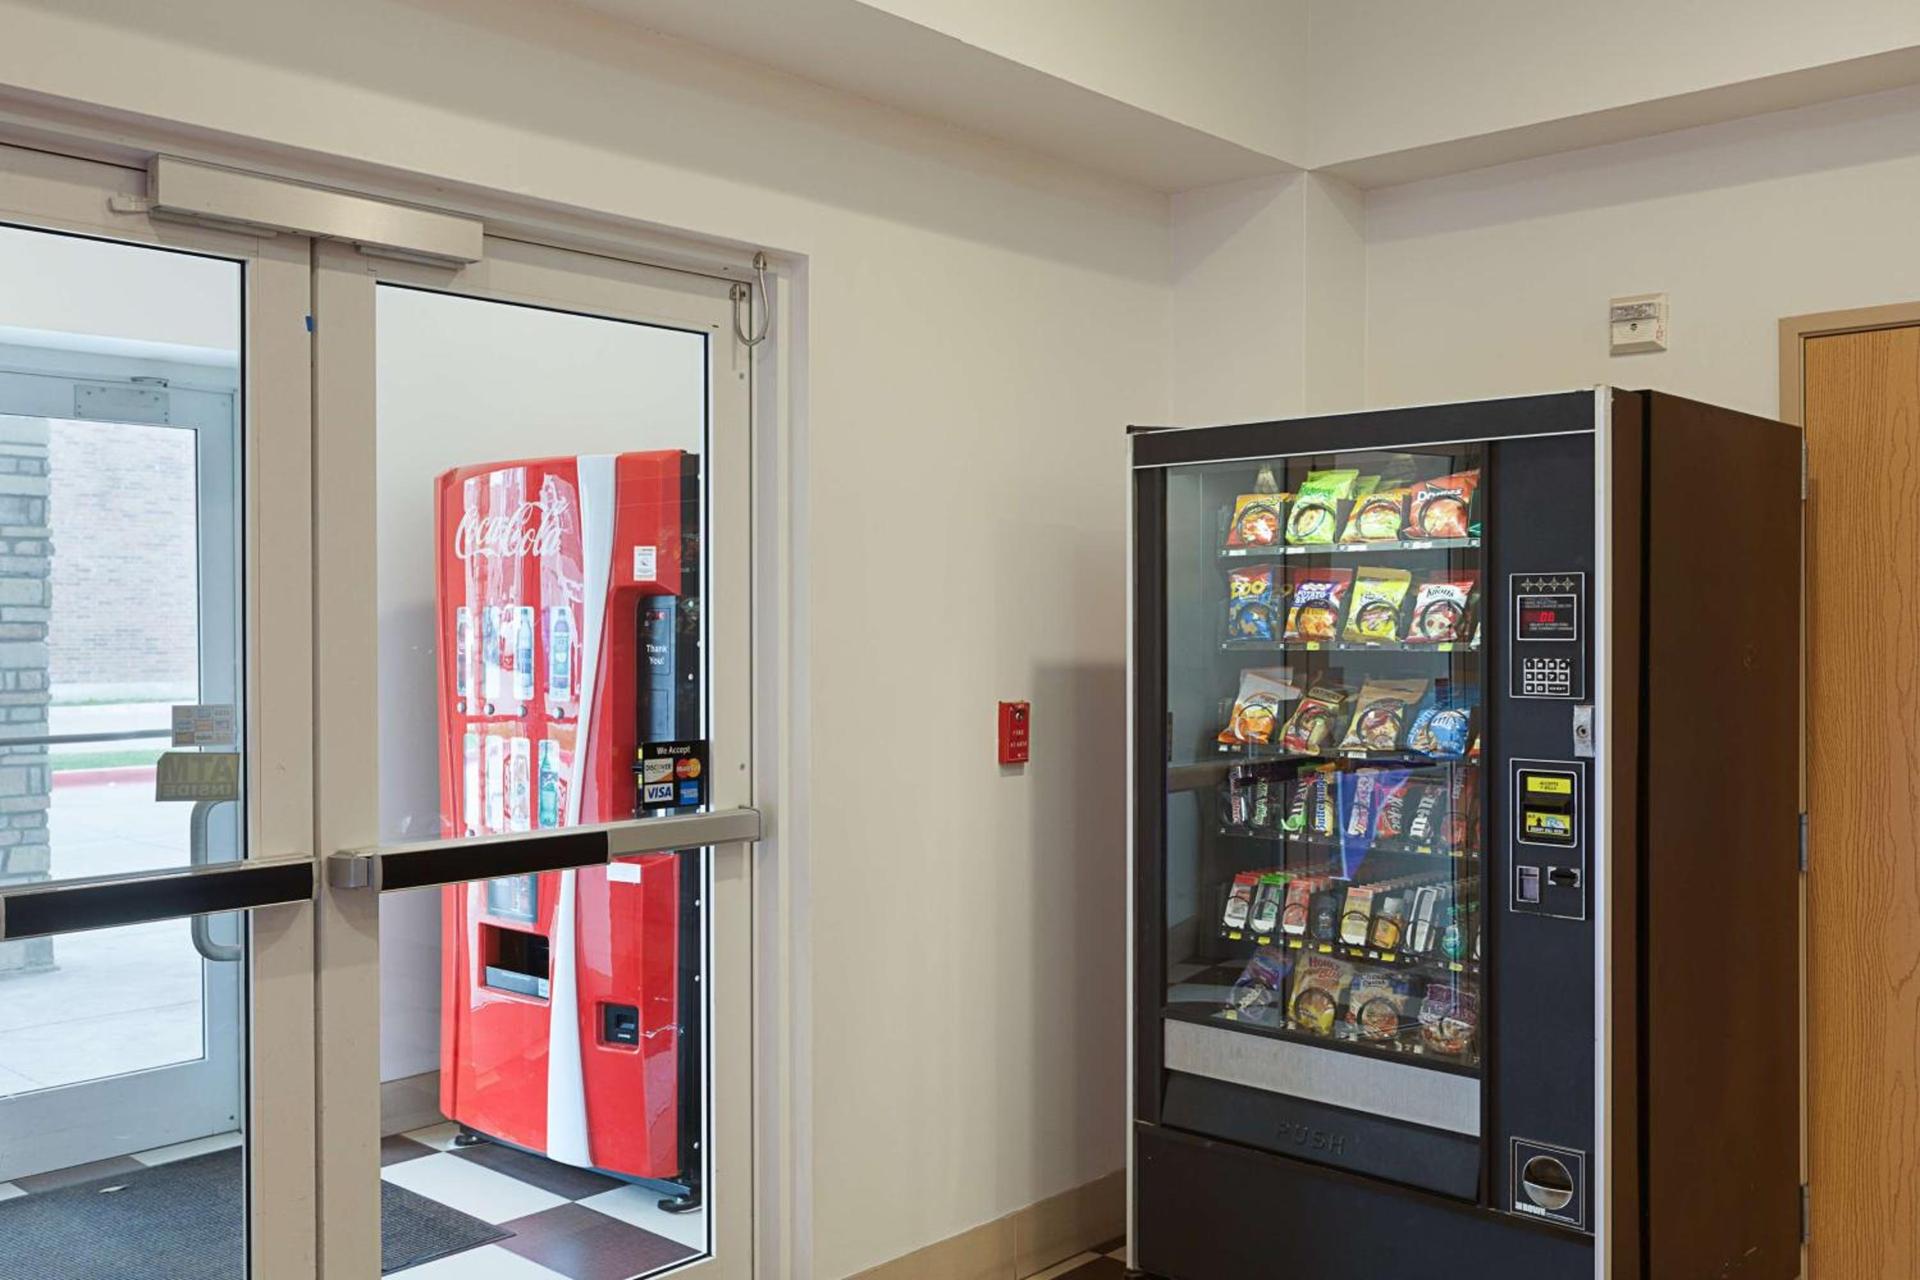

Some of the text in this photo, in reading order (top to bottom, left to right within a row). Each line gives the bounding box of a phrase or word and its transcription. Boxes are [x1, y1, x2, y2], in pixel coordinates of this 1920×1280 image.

[646, 644, 669, 653] Thank
[656, 745, 691, 756] We Accept
[648, 786, 672, 799] VISA
